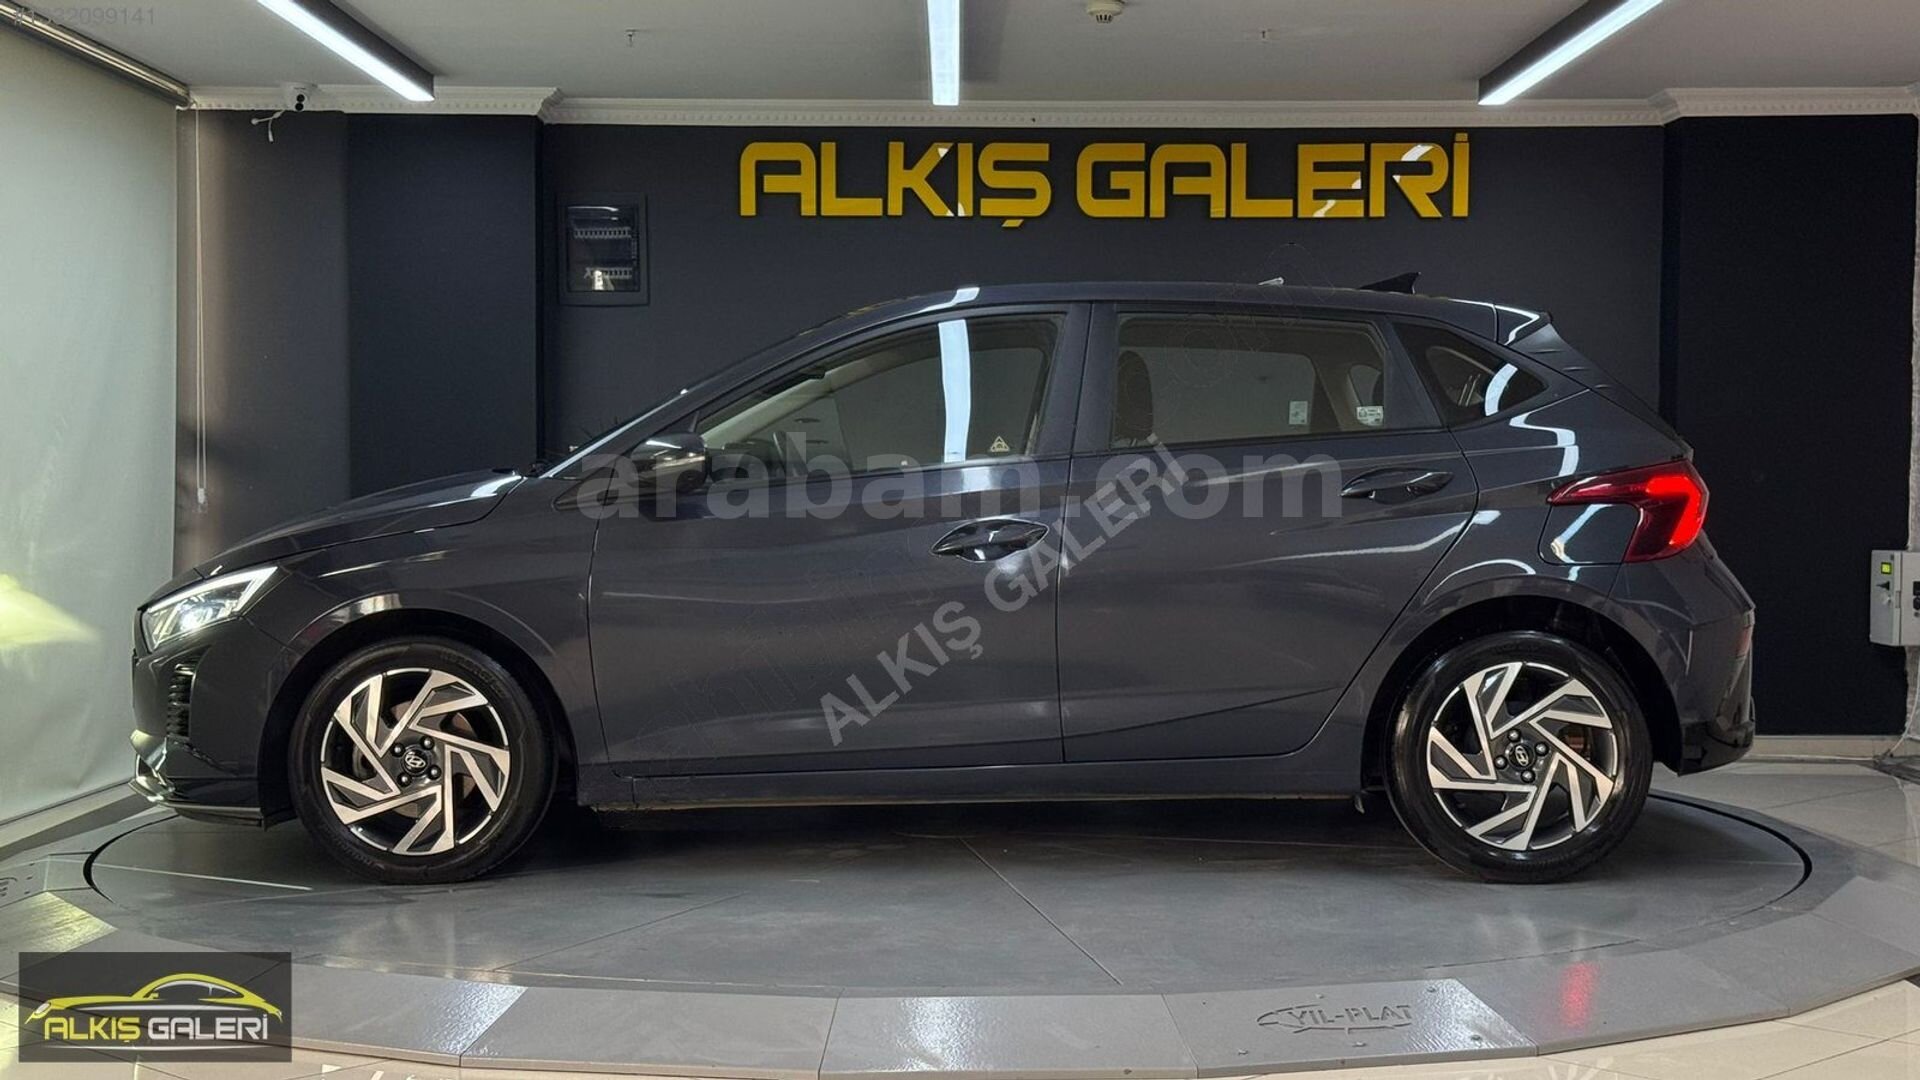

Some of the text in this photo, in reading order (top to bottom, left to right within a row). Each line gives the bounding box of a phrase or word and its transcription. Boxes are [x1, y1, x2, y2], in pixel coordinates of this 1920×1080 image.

[739, 132, 1470, 228] ALKIŞ GALERİ
[1287, 1005, 1413, 1025] YIL-PLAT
